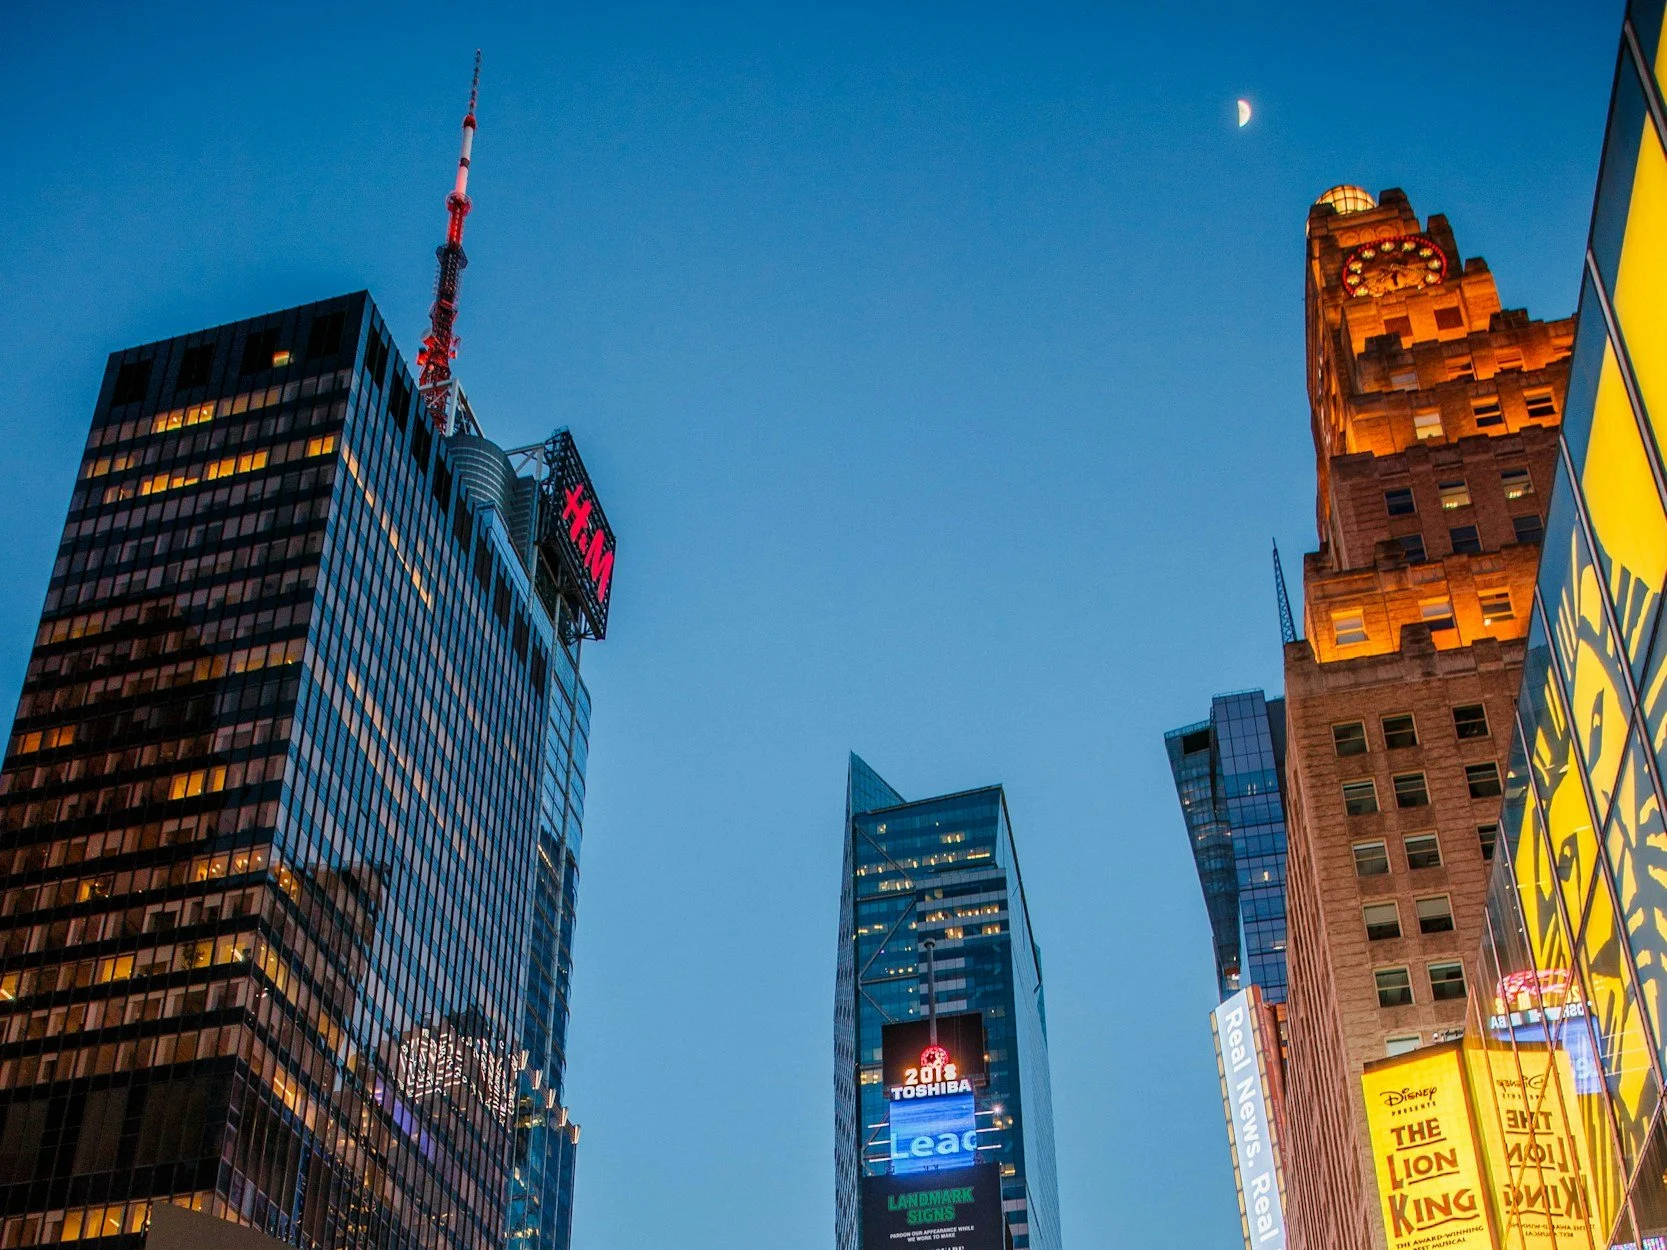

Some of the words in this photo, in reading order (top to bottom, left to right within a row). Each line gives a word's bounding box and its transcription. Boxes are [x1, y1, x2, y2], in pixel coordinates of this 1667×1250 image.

[1224, 1006, 1251, 1072] Real
[905, 1063, 957, 1085] 2018
[890, 1078, 973, 1100] TOSHIBA
[1379, 1086, 1437, 1107] Disney
[1391, 1101, 1437, 1116] PRESENTS
[1237, 1076, 1261, 1168] News.
[1390, 1117, 1442, 1147] THE
[1387, 1148, 1459, 1191] LION
[888, 1187, 975, 1211] LANDMARK
[1251, 1172, 1280, 1242] Real
[907, 1204, 956, 1226] SIGNS
[1388, 1188, 1478, 1239] KING
[889, 1231, 911, 1239] PARDON
[923, 1226, 957, 1236] APPEARANCE
[1396, 1240, 1412, 1250] THE
[1412, 1225, 1484, 1246] AWARD-WINNING
[1431, 1236, 1466, 1250] MUSICAL
